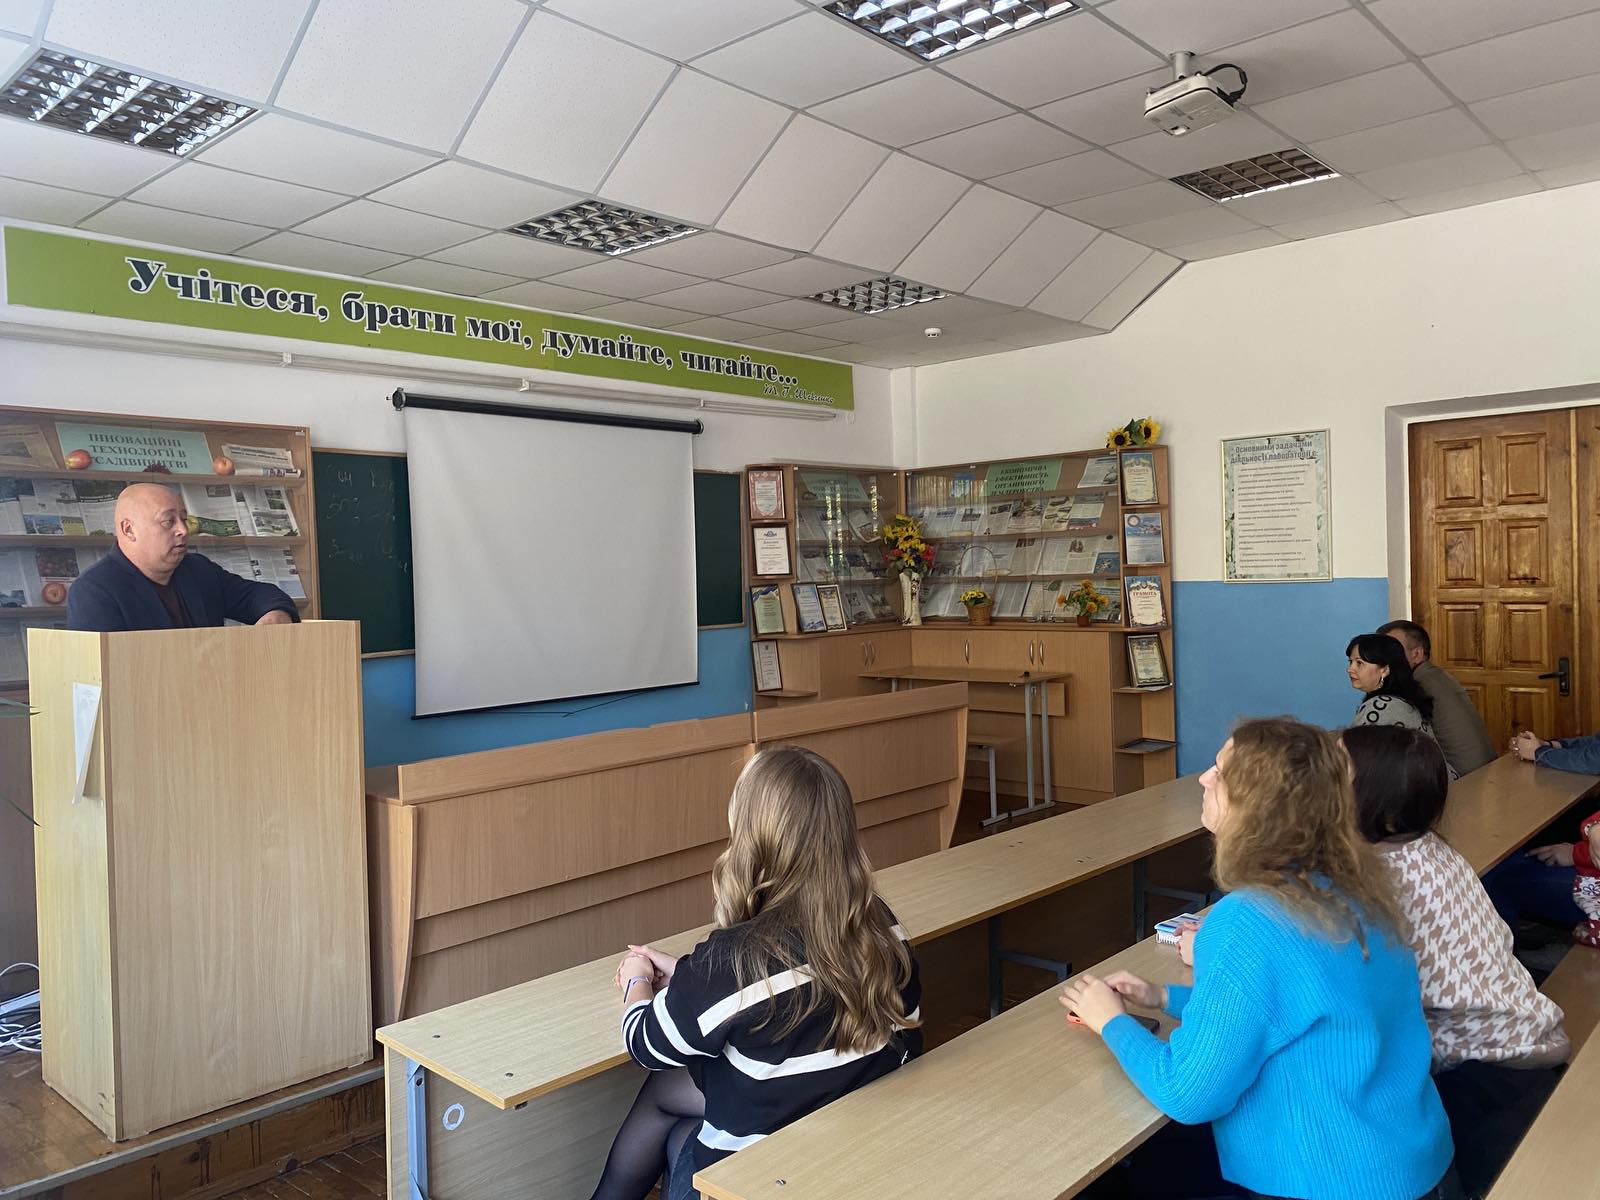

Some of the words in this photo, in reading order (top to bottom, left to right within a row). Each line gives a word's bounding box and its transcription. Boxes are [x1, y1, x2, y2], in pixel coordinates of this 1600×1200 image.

[125, 257, 329, 322] Учітеся,
[341, 291, 457, 335] брати
[465, 316, 533, 350] мої,
[541, 328, 674, 370] думайте,
[679, 350, 798, 386] читайте...
[88, 433, 182, 447] ІННОВАЦІЙНІ
[89, 445, 175, 457] ТЕХНОЛОГІЇ
